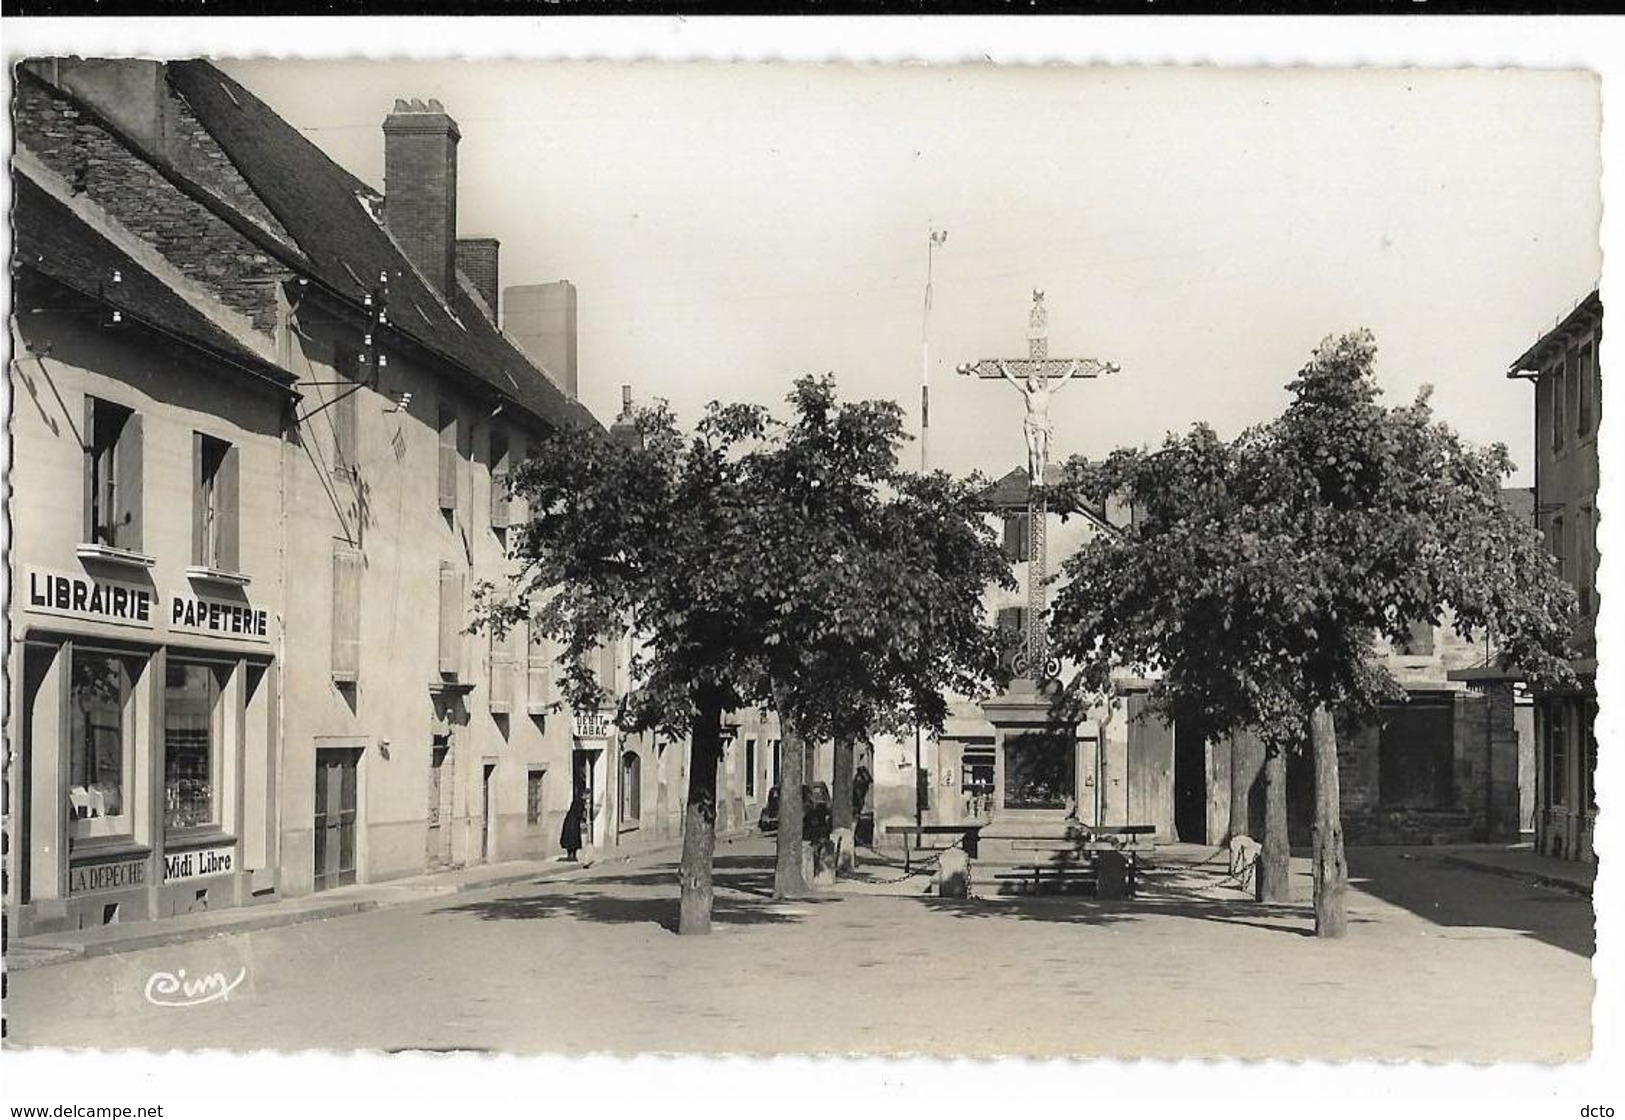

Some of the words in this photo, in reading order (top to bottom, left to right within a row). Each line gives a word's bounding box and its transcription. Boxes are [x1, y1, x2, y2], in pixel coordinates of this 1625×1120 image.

[31, 572, 150, 621] LIBRAIRIE
[172, 597, 267, 636] PAPETERIE
[577, 725, 607, 736] TABAC
[70, 867, 87, 892] LA
[90, 862, 144, 890] DEPECHE
[164, 855, 192, 880] Midi
[199, 851, 232, 874] Libre
